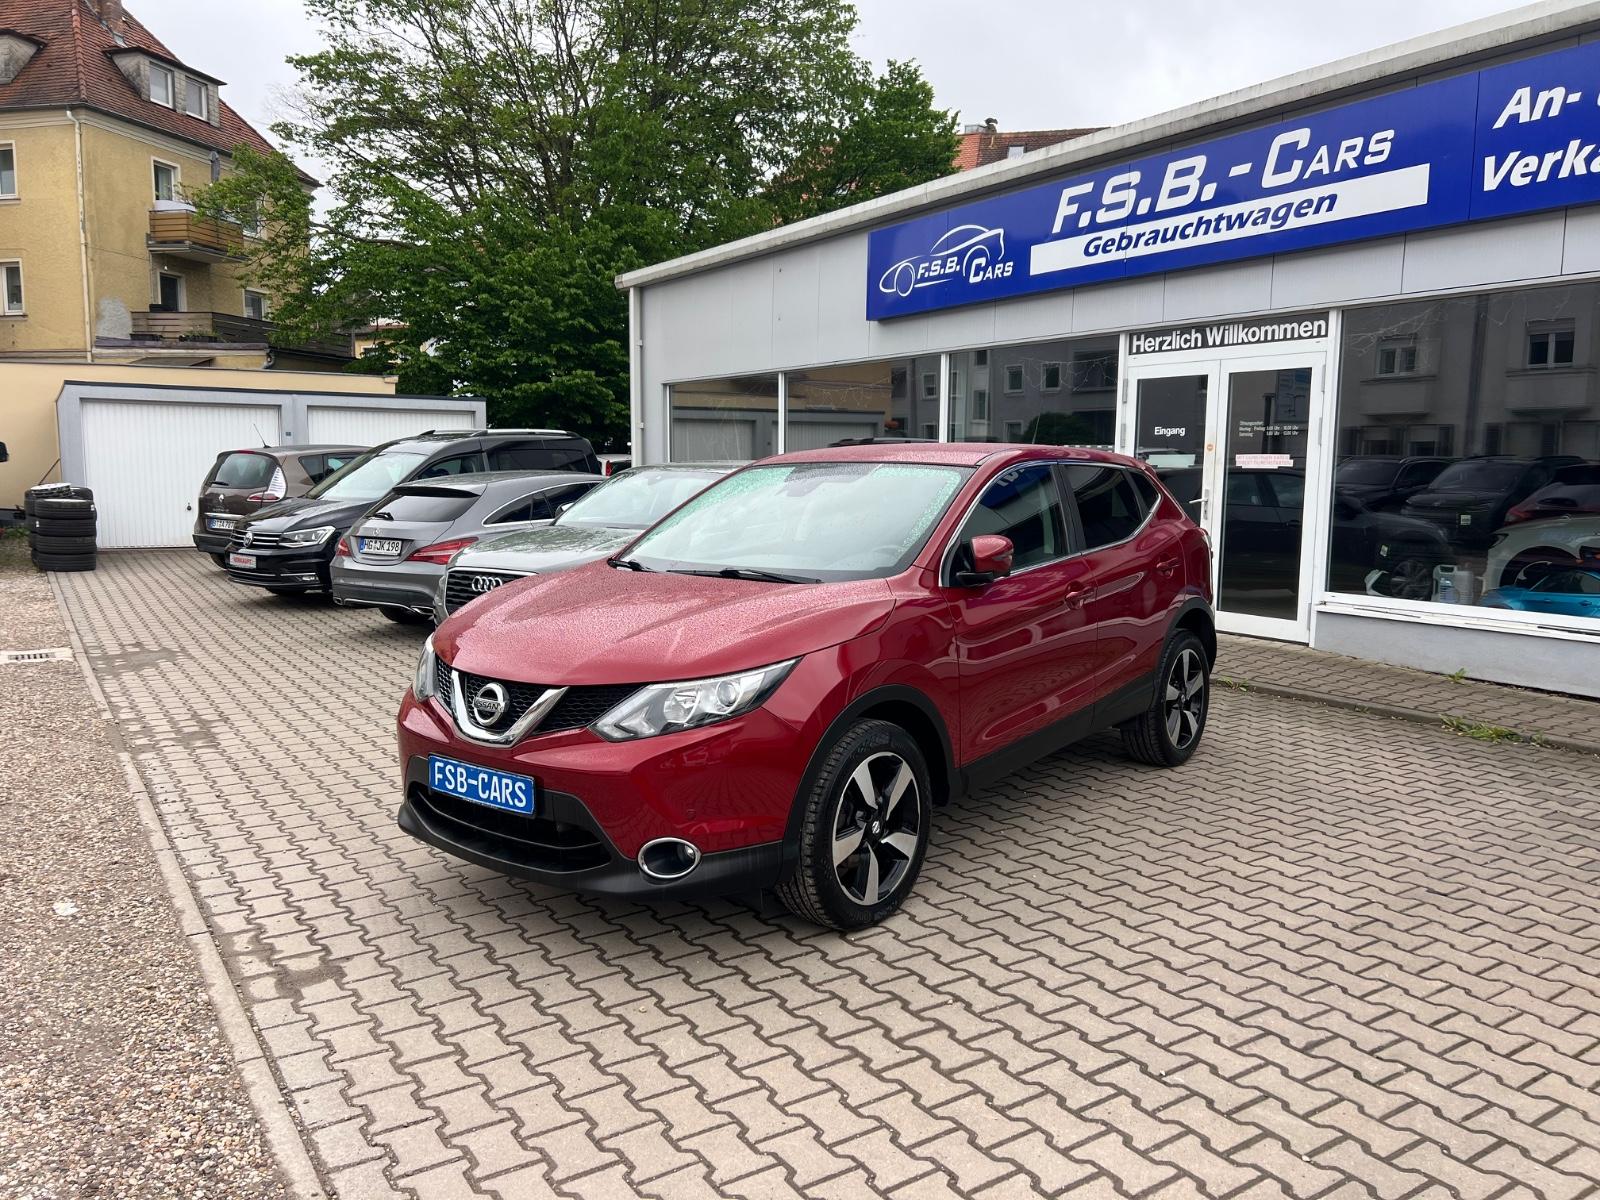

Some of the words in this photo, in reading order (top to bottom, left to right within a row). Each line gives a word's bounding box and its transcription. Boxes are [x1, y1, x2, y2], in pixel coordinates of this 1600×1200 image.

[1492, 86, 1582, 129] An-
[1083, 193, 1338, 257] Gebrauchtwagen
[917, 256, 961, 279] F.S.B.
[1131, 328, 1202, 353] Herzlich
[1206, 319, 1326, 346] Willkommen
[1154, 426, 1186, 437] Eingang
[386, 541, 400, 552] 198
[433, 760, 527, 809] FSB-CARS
